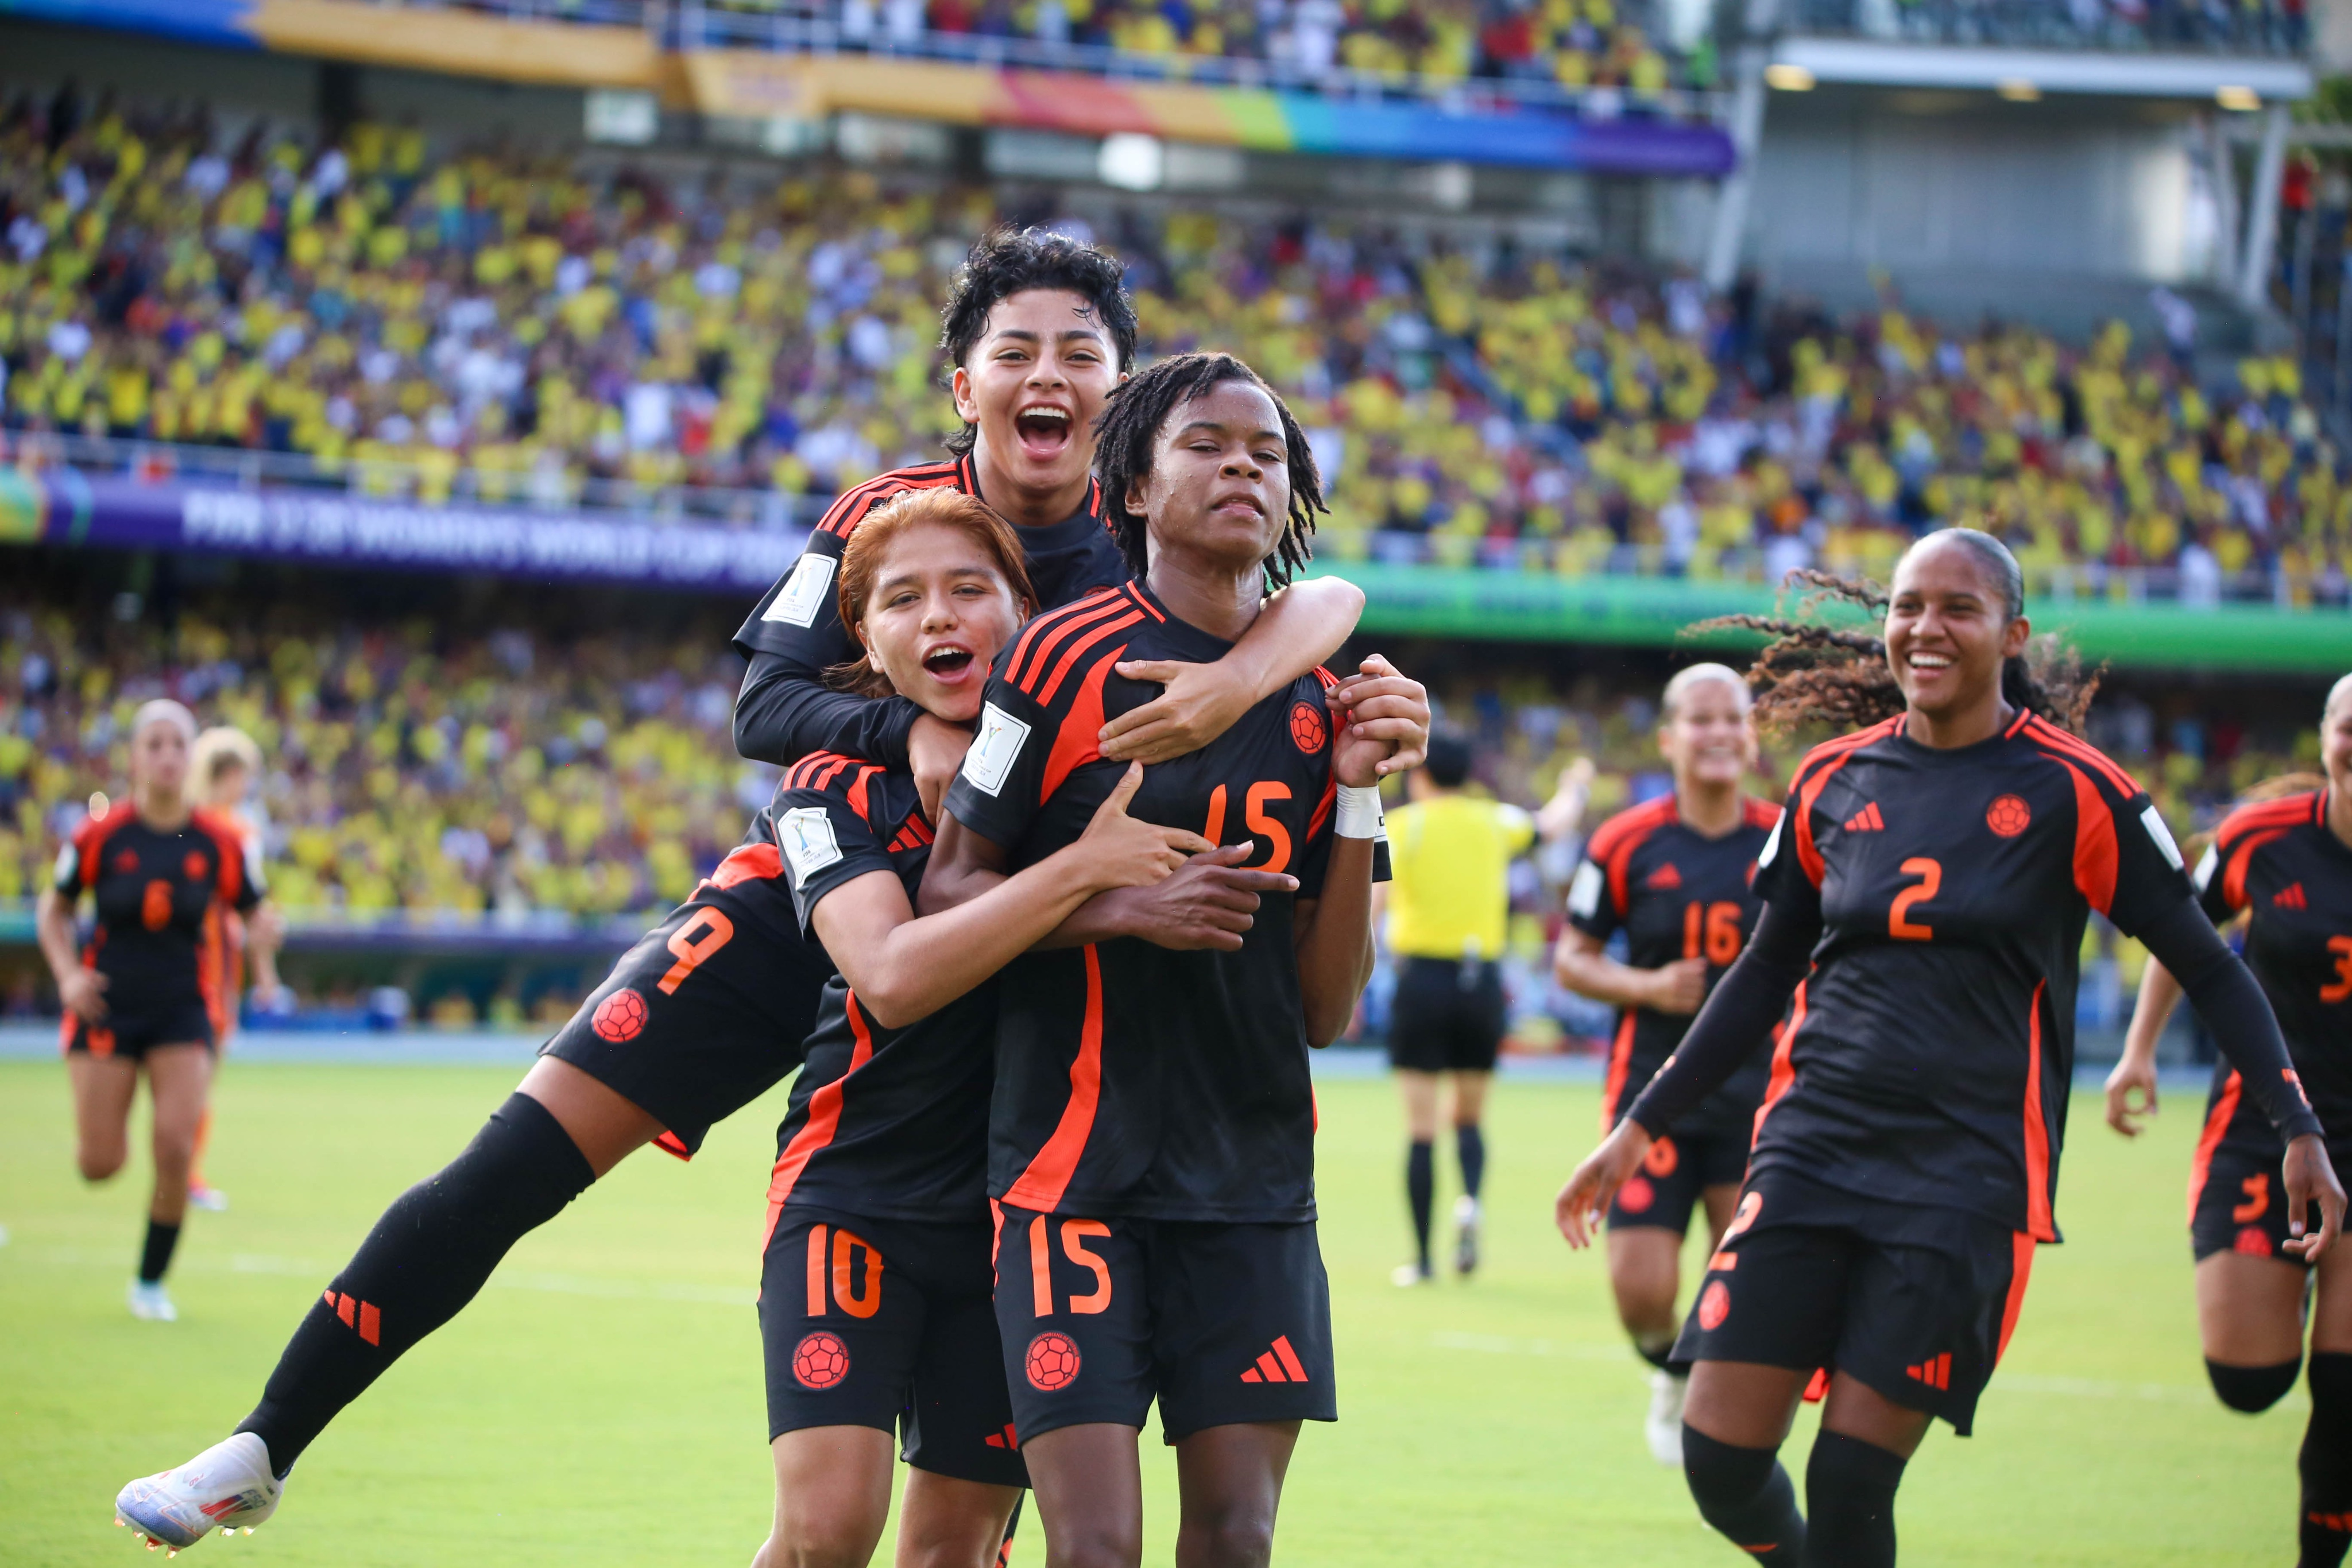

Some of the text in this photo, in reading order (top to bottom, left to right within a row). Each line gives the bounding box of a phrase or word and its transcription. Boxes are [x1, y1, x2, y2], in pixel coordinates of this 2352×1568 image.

[1204, 781, 1292, 873] 15
[142, 878, 172, 932] 6
[1682, 900, 1742, 966] 16
[1889, 857, 1941, 940] 2
[657, 905, 734, 996] 9
[807, 1222, 884, 1318] 10
[1029, 1214, 1112, 1318] 15
[1708, 1191, 1763, 1271] 2
[242, 1489, 267, 1507] F50
